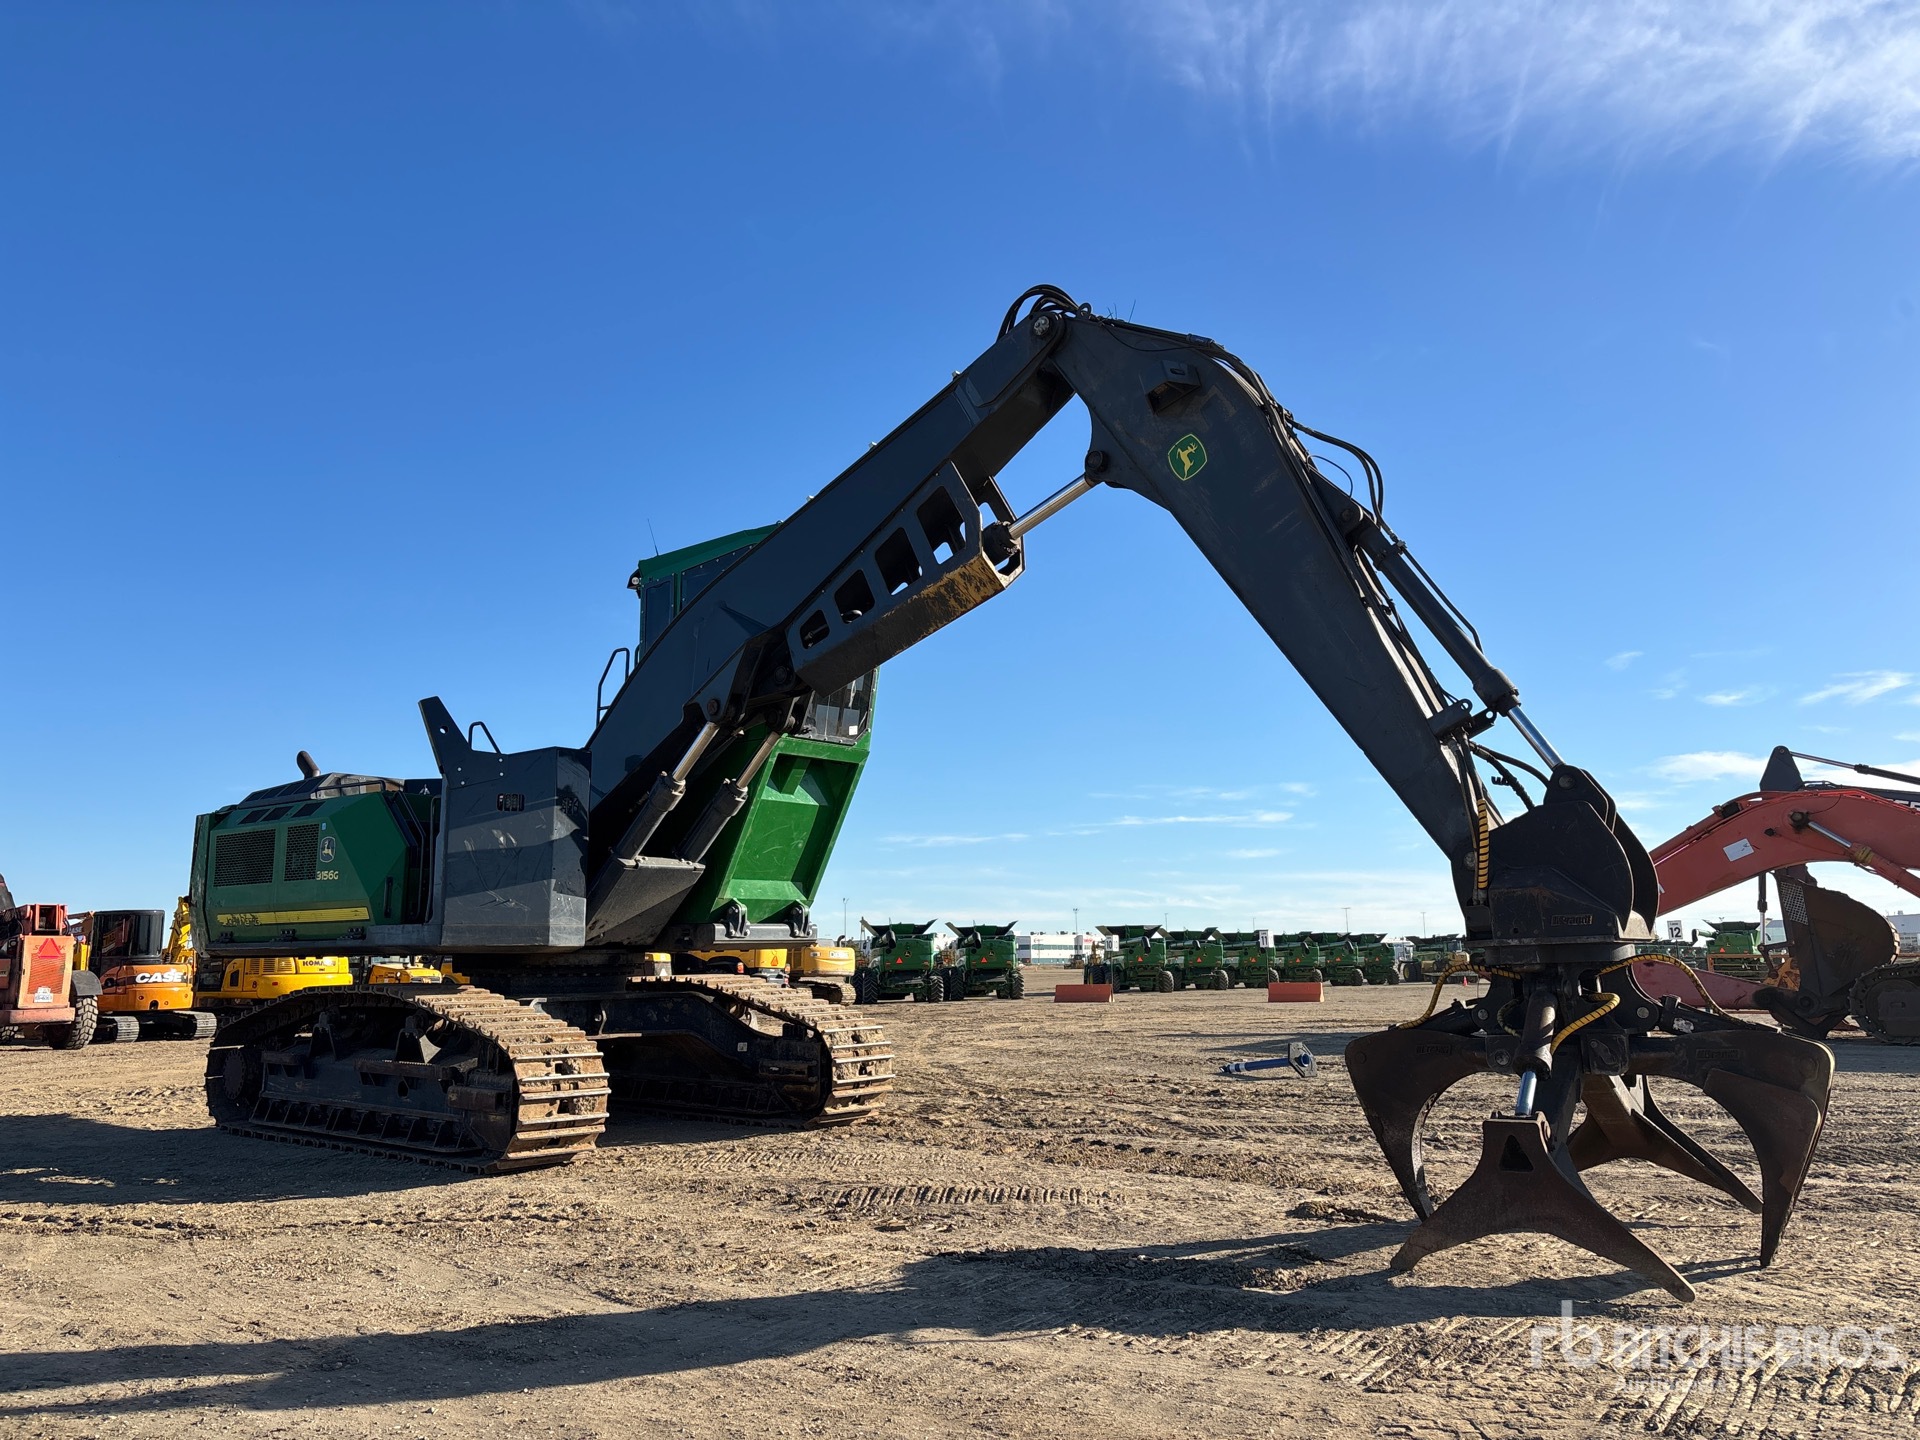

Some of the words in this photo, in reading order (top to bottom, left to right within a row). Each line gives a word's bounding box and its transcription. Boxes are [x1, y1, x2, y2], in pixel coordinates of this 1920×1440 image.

[316, 870, 339, 881] 3156G
[1669, 927, 1682, 938] 12
[1106, 940, 1113, 950] 10
[1261, 936, 1268, 946] 11
[135, 971, 184, 984] CASE
